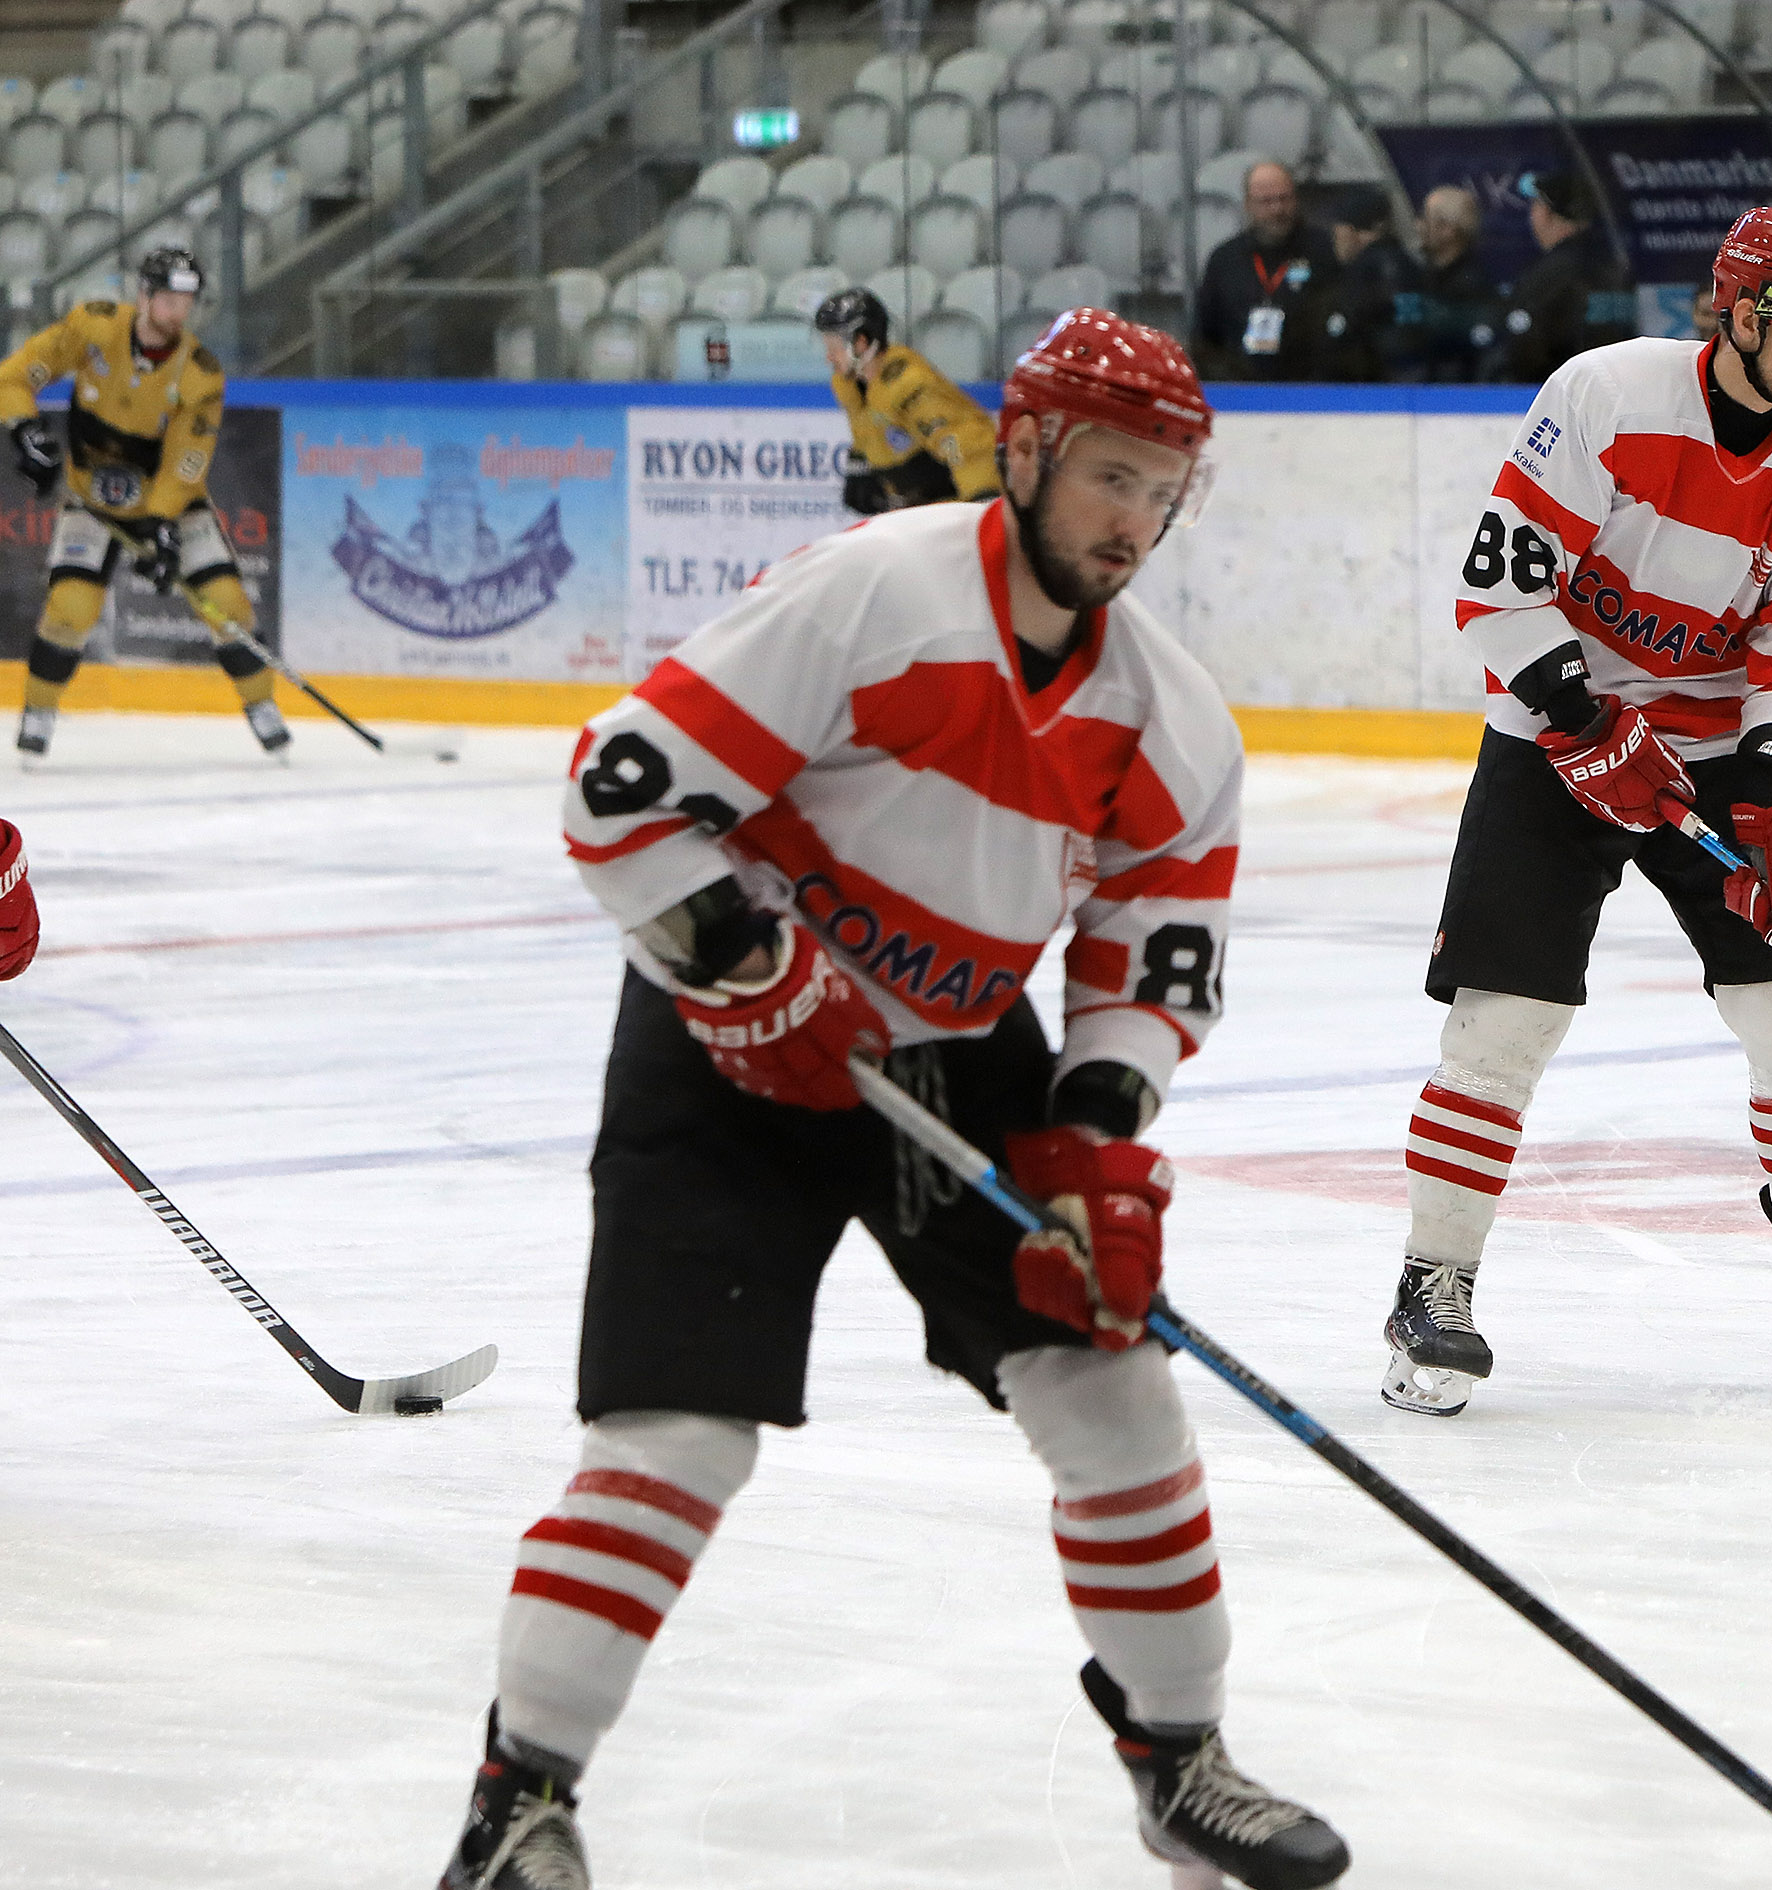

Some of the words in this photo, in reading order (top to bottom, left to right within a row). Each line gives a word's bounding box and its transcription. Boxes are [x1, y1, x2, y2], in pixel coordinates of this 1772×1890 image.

[643, 440, 744, 478] RYON
[1512, 449, 1544, 478] Kraków
[1463, 511, 1557, 593] 88
[1572, 711, 1651, 784] BAUER
[137, 1188, 284, 1330] WARRIOR
